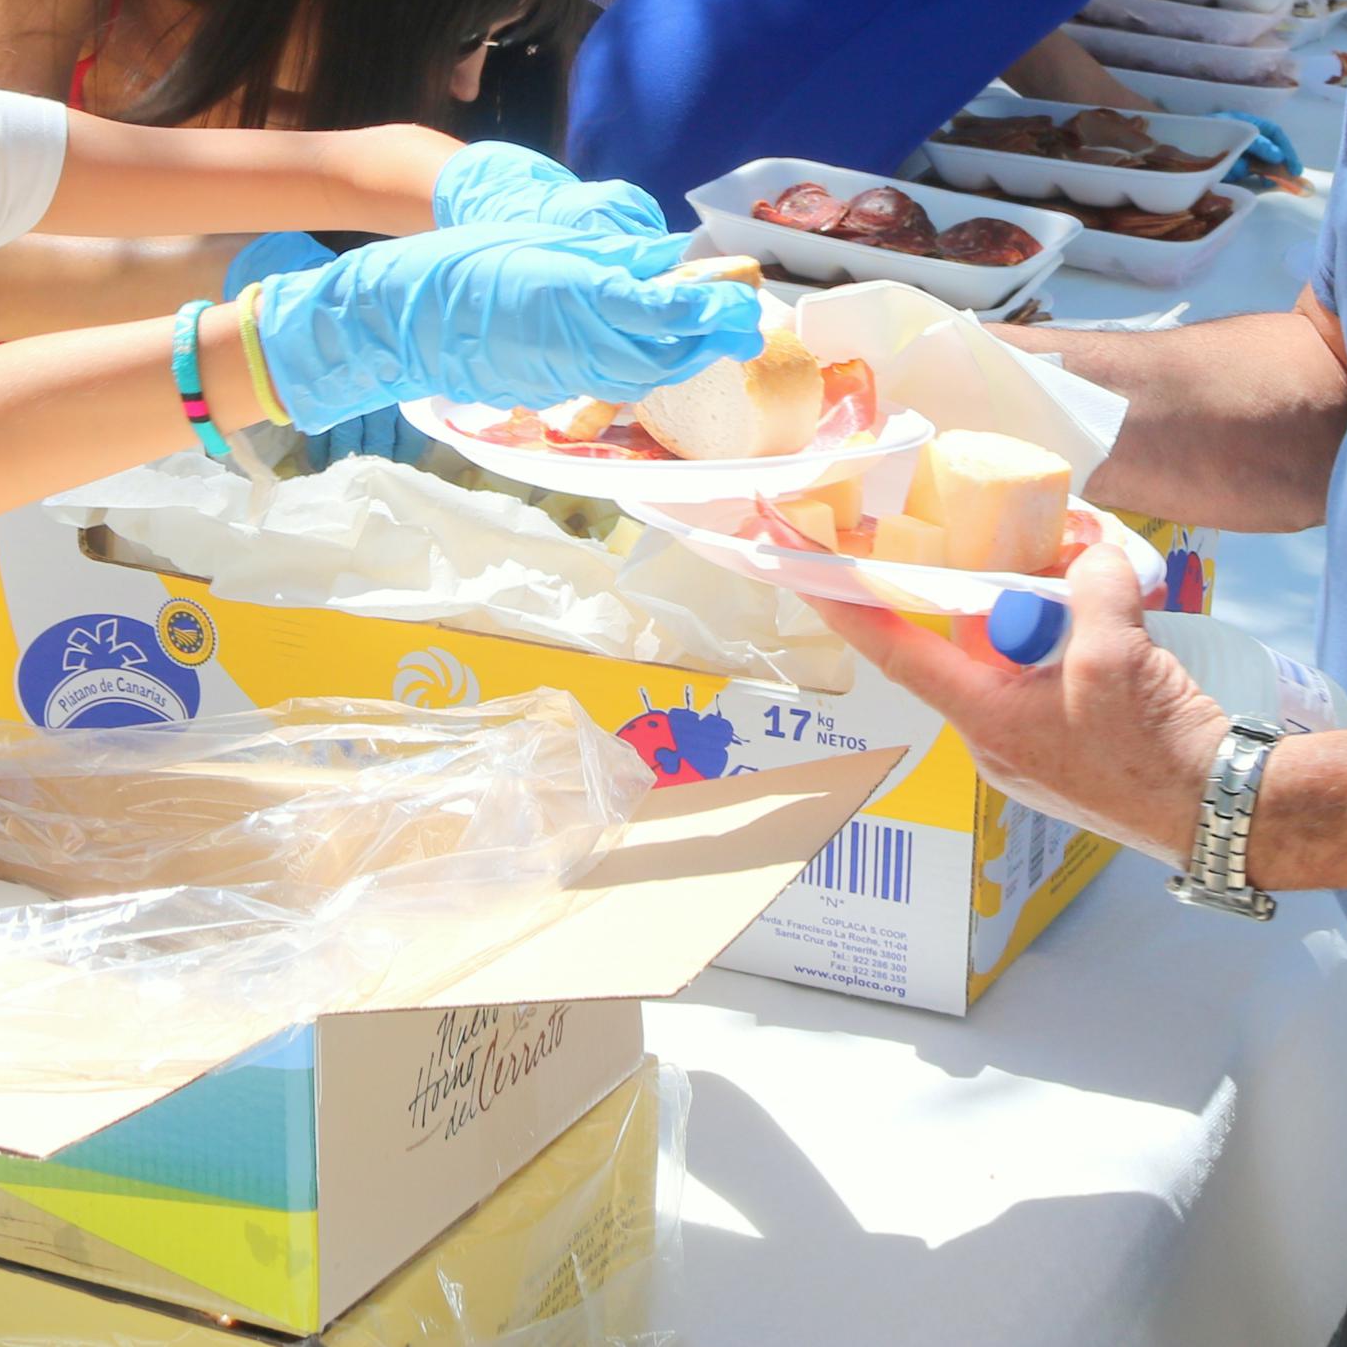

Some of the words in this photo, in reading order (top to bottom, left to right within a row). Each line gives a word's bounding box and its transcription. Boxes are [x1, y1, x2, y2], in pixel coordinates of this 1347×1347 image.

[58, 684, 97, 712] Plátano
[100, 678, 113, 692] de
[116, 677, 167, 708] Canarias
[764, 705, 811, 741] 17
[817, 712, 834, 731] kg
[817, 732, 867, 751] NETOS
[787, 919, 832, 937] Francisco
[834, 931, 846, 940] La
[822, 917, 867, 933] COPLACA
[774, 928, 801, 941] Santa
[803, 934, 824, 946] Cruz
[827, 940, 838, 949] de
[841, 942, 878, 957] Tenerife
[794, 965, 906, 998] www.coplaca.org
[479, 1004, 572, 1111] Cerrato
[409, 1045, 482, 1129] Horno
